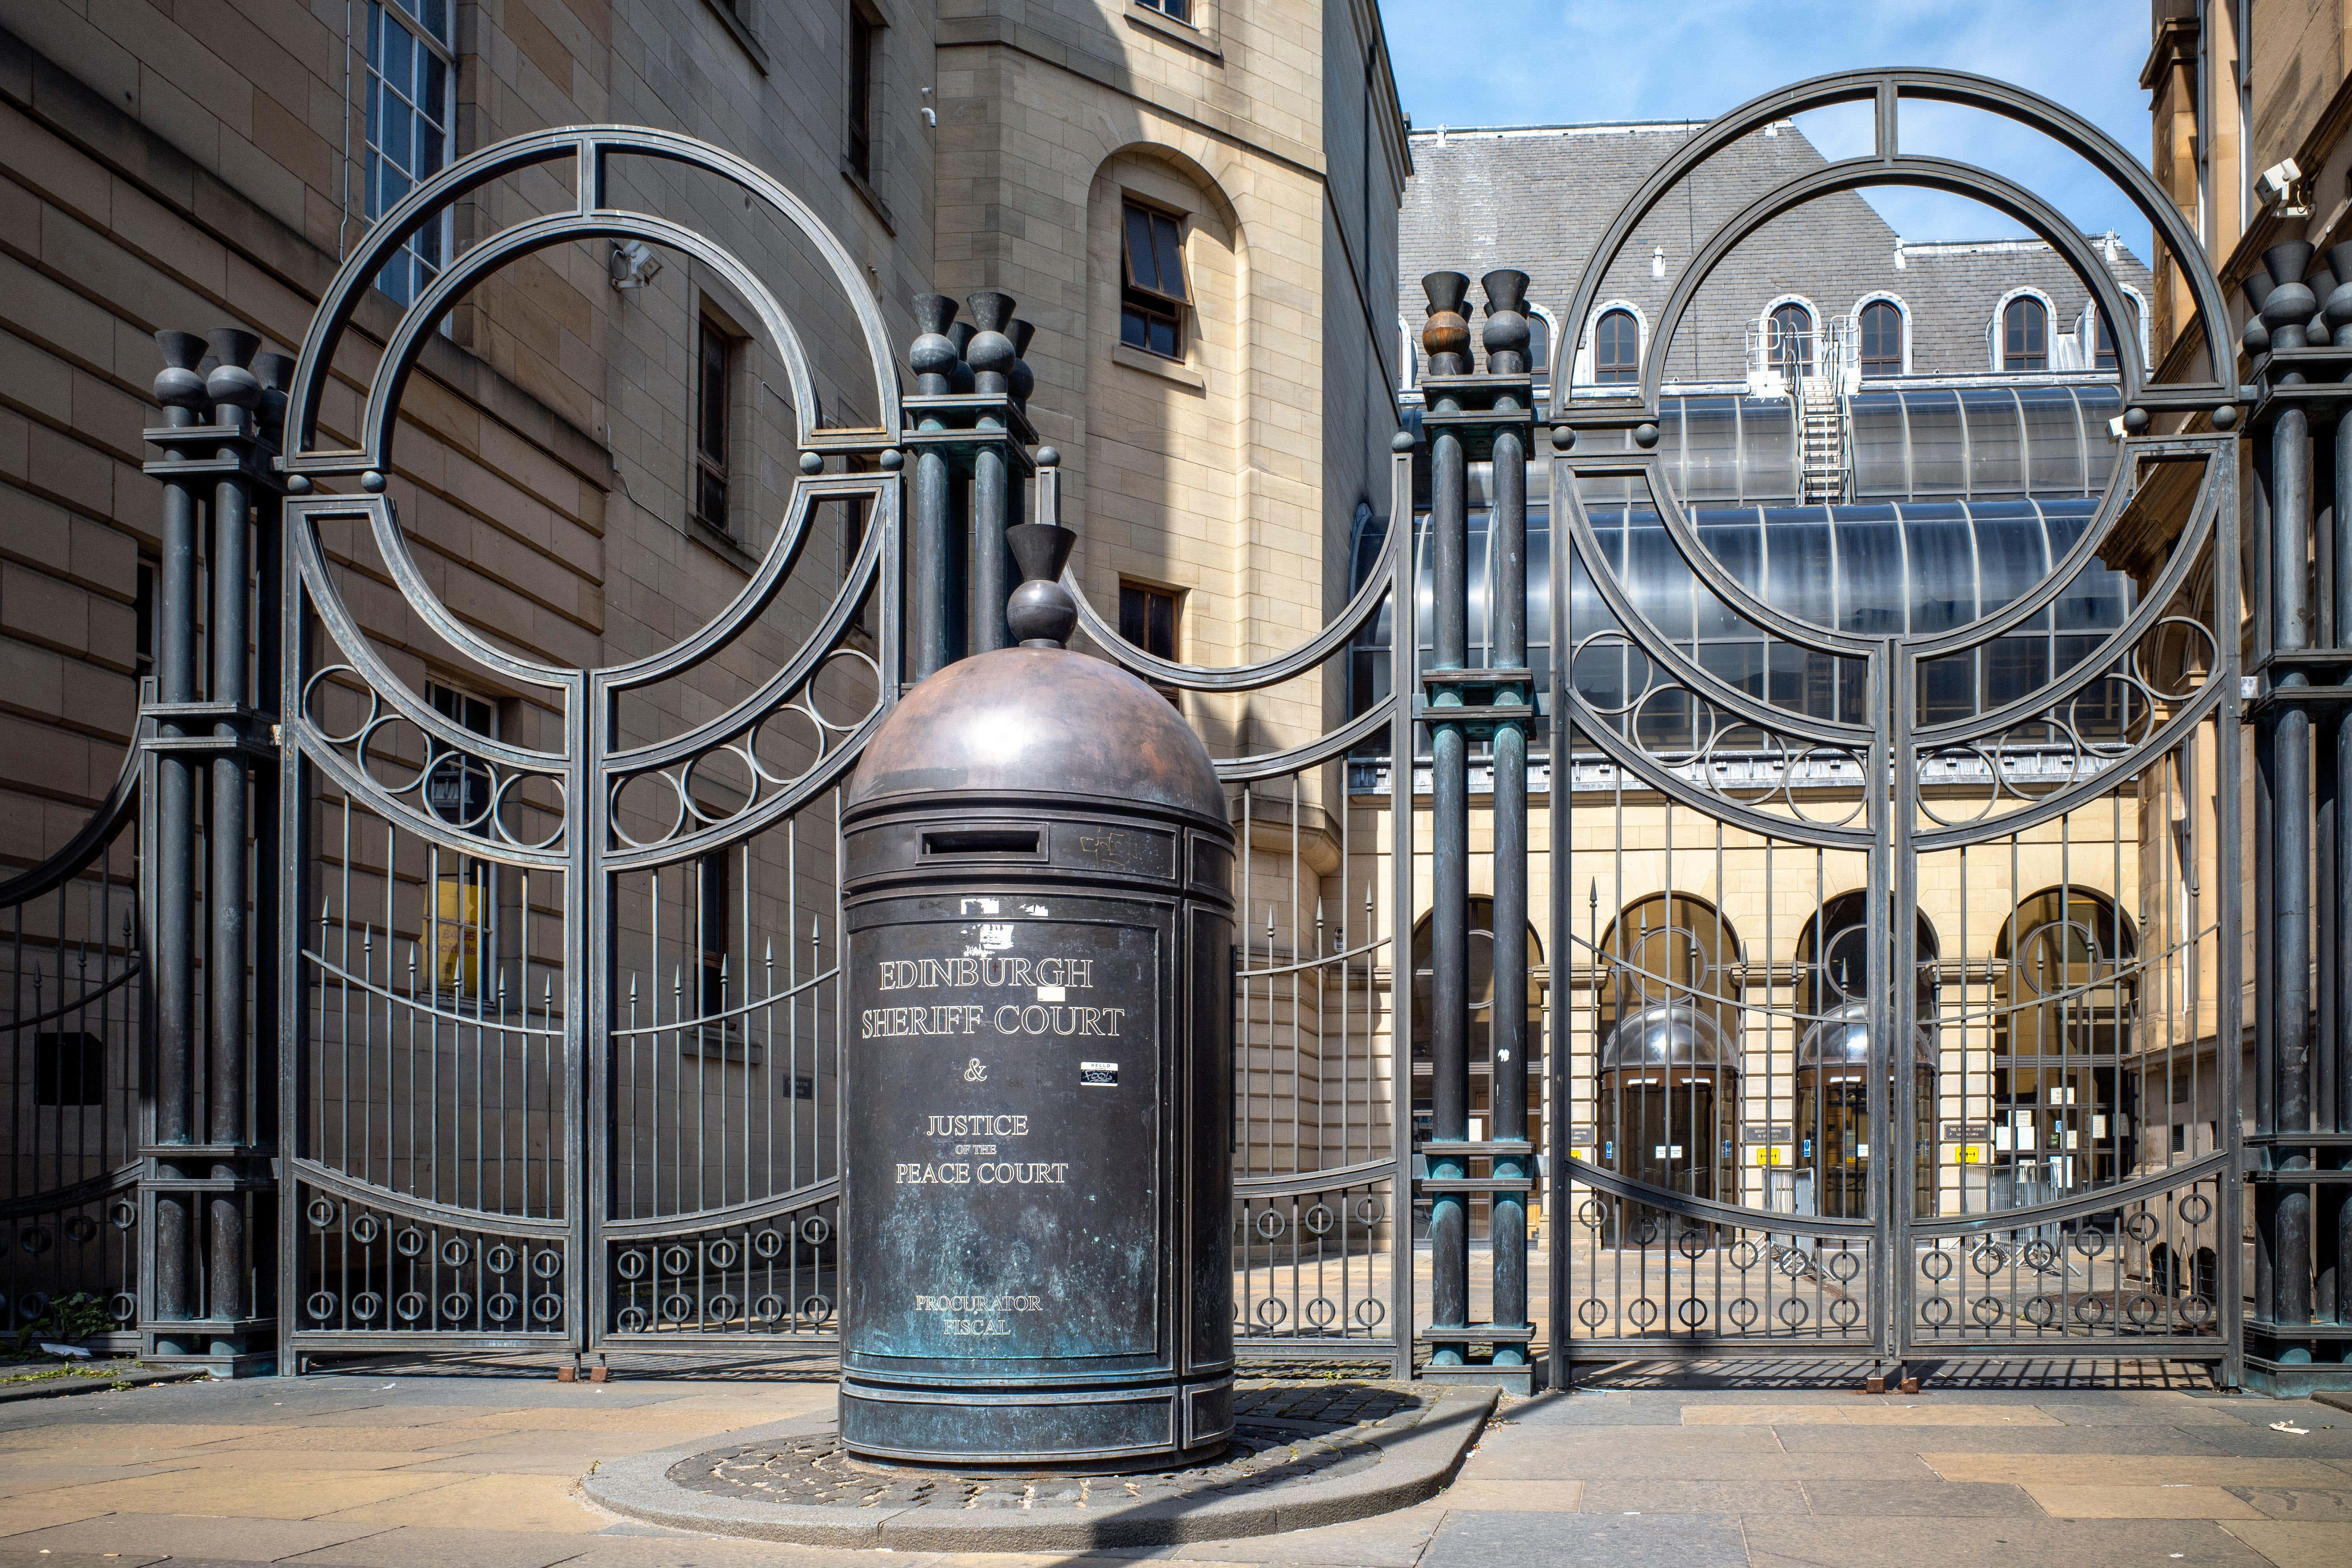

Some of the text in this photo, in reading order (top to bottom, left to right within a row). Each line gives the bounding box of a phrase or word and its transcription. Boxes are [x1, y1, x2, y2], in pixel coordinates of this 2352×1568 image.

[879, 958, 1093, 990] EDINBURGH
[862, 1005, 1125, 1039] SHERIFF COURT
[964, 1058, 987, 1081] &
[927, 1115, 1029, 1136] JUSTICE
[955, 1145, 997, 1154] OF THE
[896, 1163, 1069, 1183] PEACE COURT
[916, 1295, 1043, 1311] PROCURATOR
[944, 1319, 1011, 1335] FISCAL
